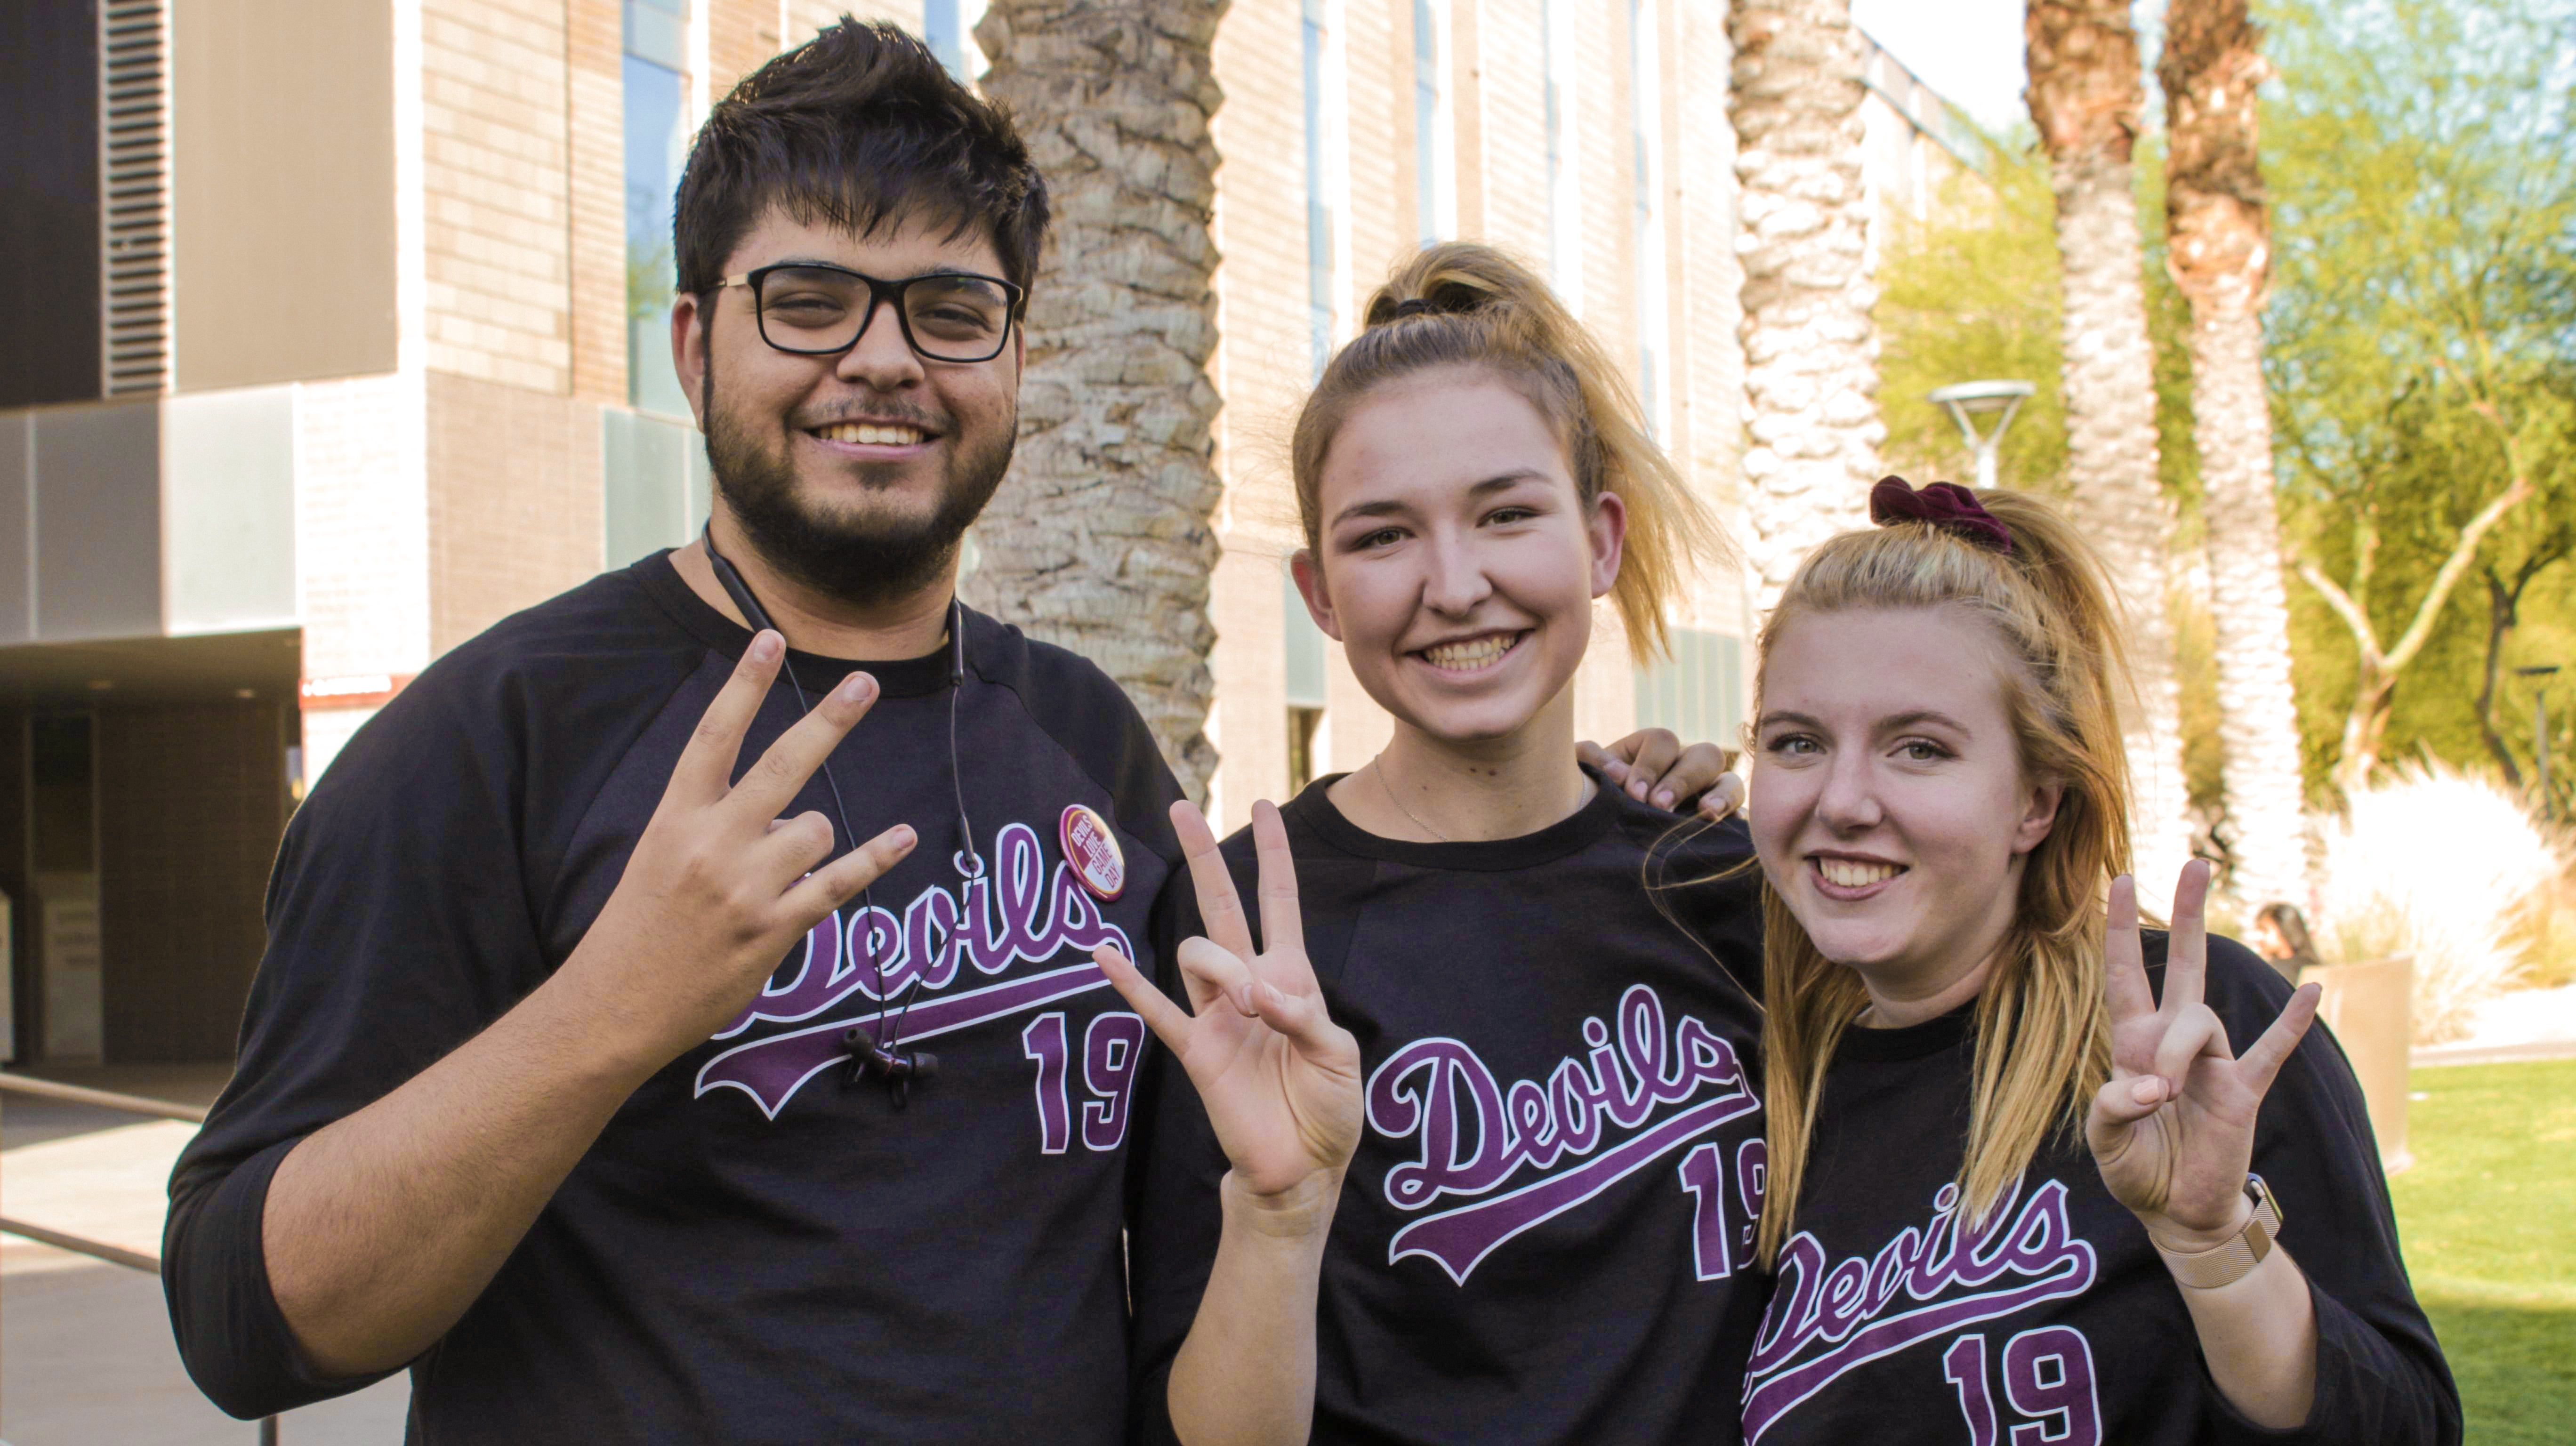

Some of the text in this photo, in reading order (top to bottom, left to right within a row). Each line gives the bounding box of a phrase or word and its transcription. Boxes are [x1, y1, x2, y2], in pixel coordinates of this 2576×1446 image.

[1071, 815, 1093, 847] DEVILS
[1083, 831, 1101, 858] LOVE
[1092, 844, 1112, 875] GAME
[1105, 863, 1120, 889] DAY
[1022, 1011, 1144, 1154] 19
[1366, 984, 1745, 1210] Devils
[1943, 1326, 2102, 1446] 19
